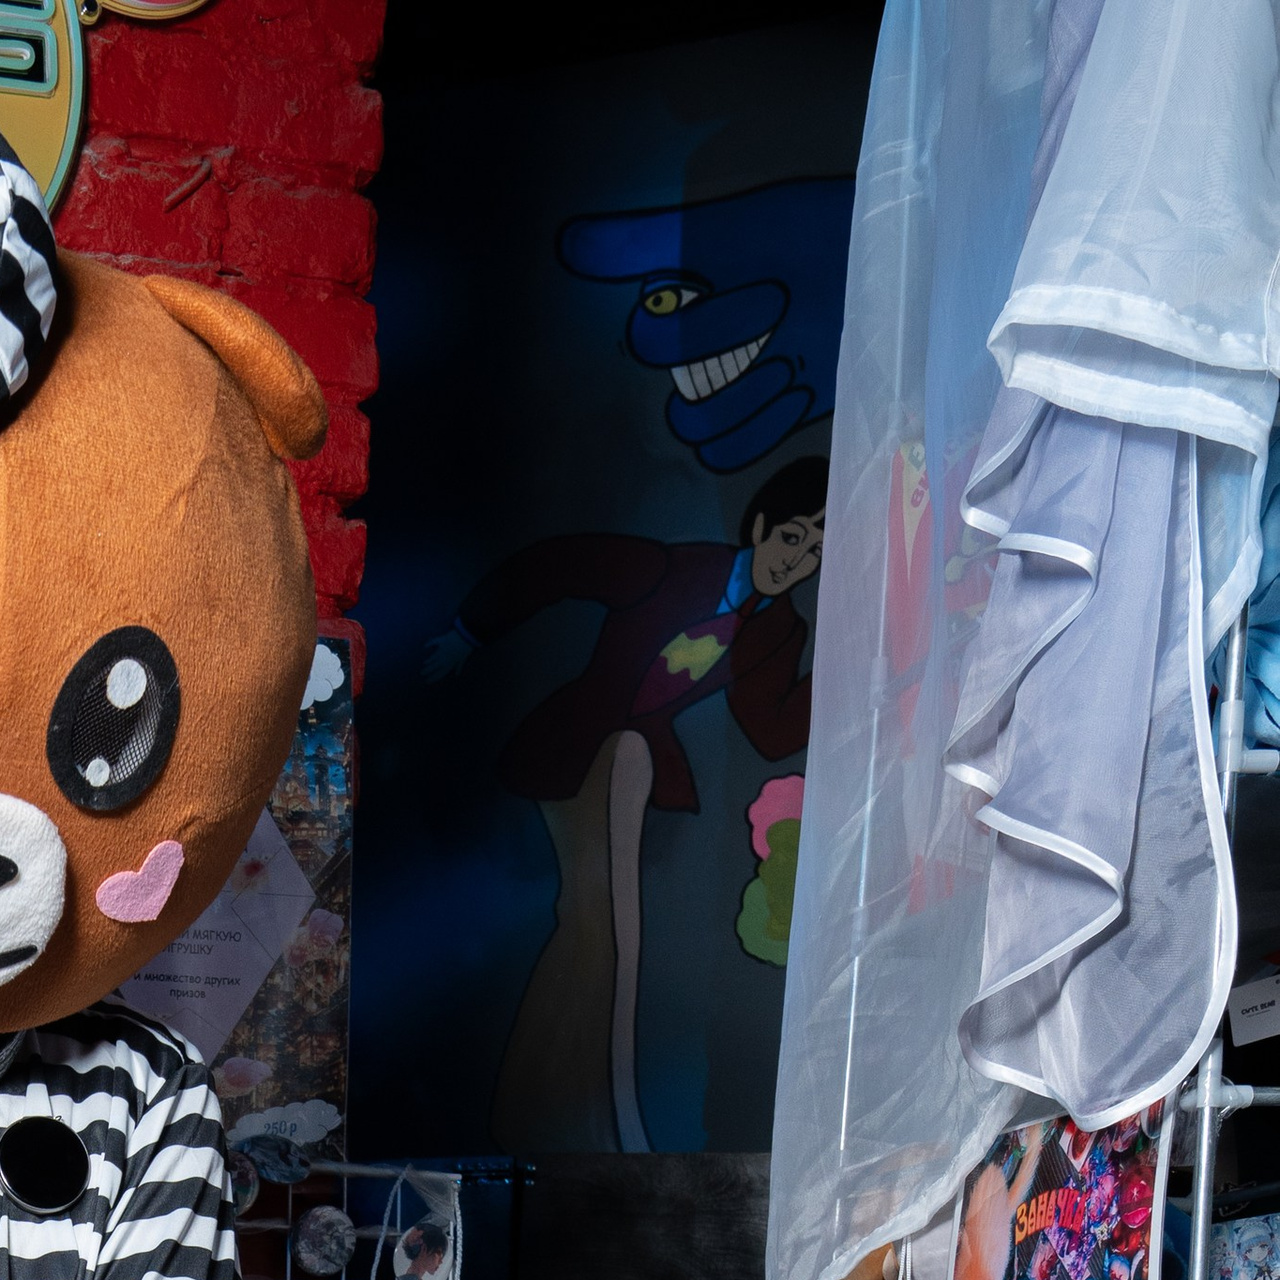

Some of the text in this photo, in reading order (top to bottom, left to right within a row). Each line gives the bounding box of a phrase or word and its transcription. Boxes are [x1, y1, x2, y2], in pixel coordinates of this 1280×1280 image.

[192, 930, 242, 942] МЯГКУЮ
[144, 973, 201, 984] множество
[204, 976, 241, 988] других
[169, 989, 206, 1000] призов
[264, 1120, 287, 1136] 250
[1015, 1188, 1087, 1246] ЗАНАЧКА
